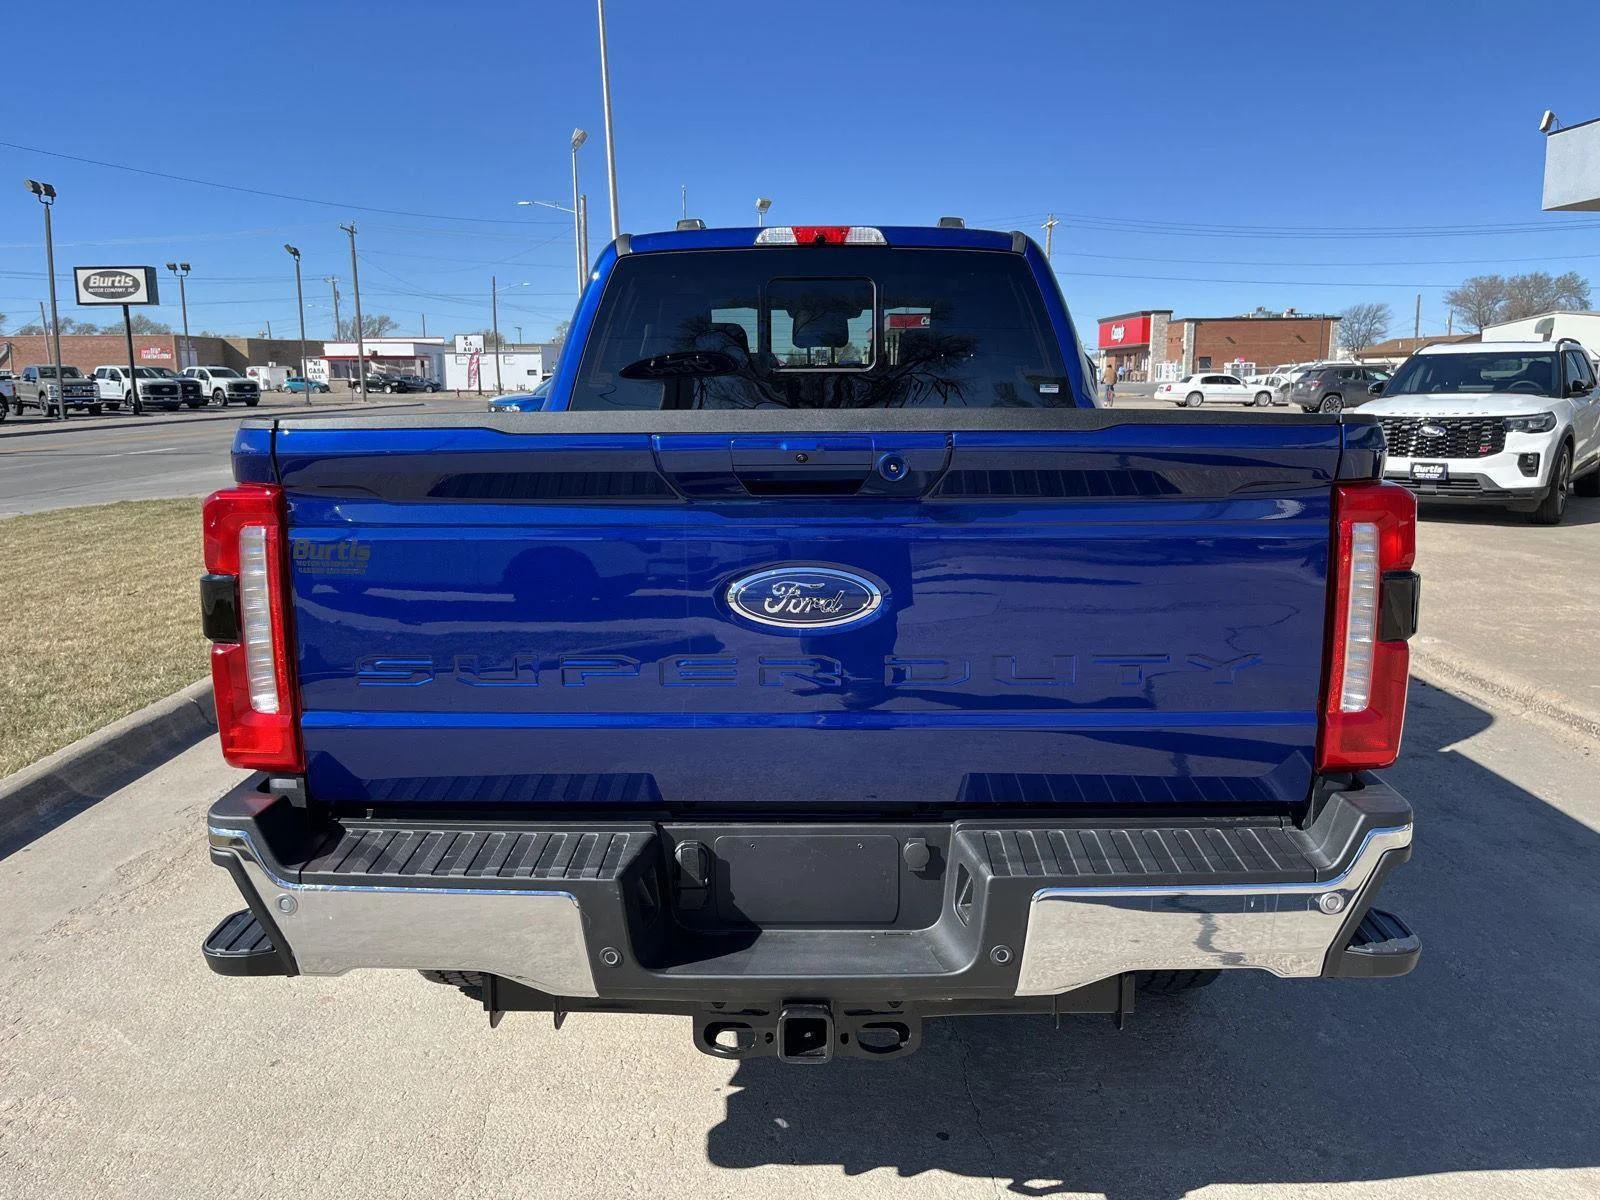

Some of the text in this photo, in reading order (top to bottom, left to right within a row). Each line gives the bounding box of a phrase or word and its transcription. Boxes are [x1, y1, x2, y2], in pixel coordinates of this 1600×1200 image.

[89, 275, 133, 287] Burtis
[1412, 464, 1444, 474] Burtis
[292, 538, 371, 560] Burtis
[763, 580, 846, 614] Ford
[354, 653, 1264, 687] SUPER DUTY
